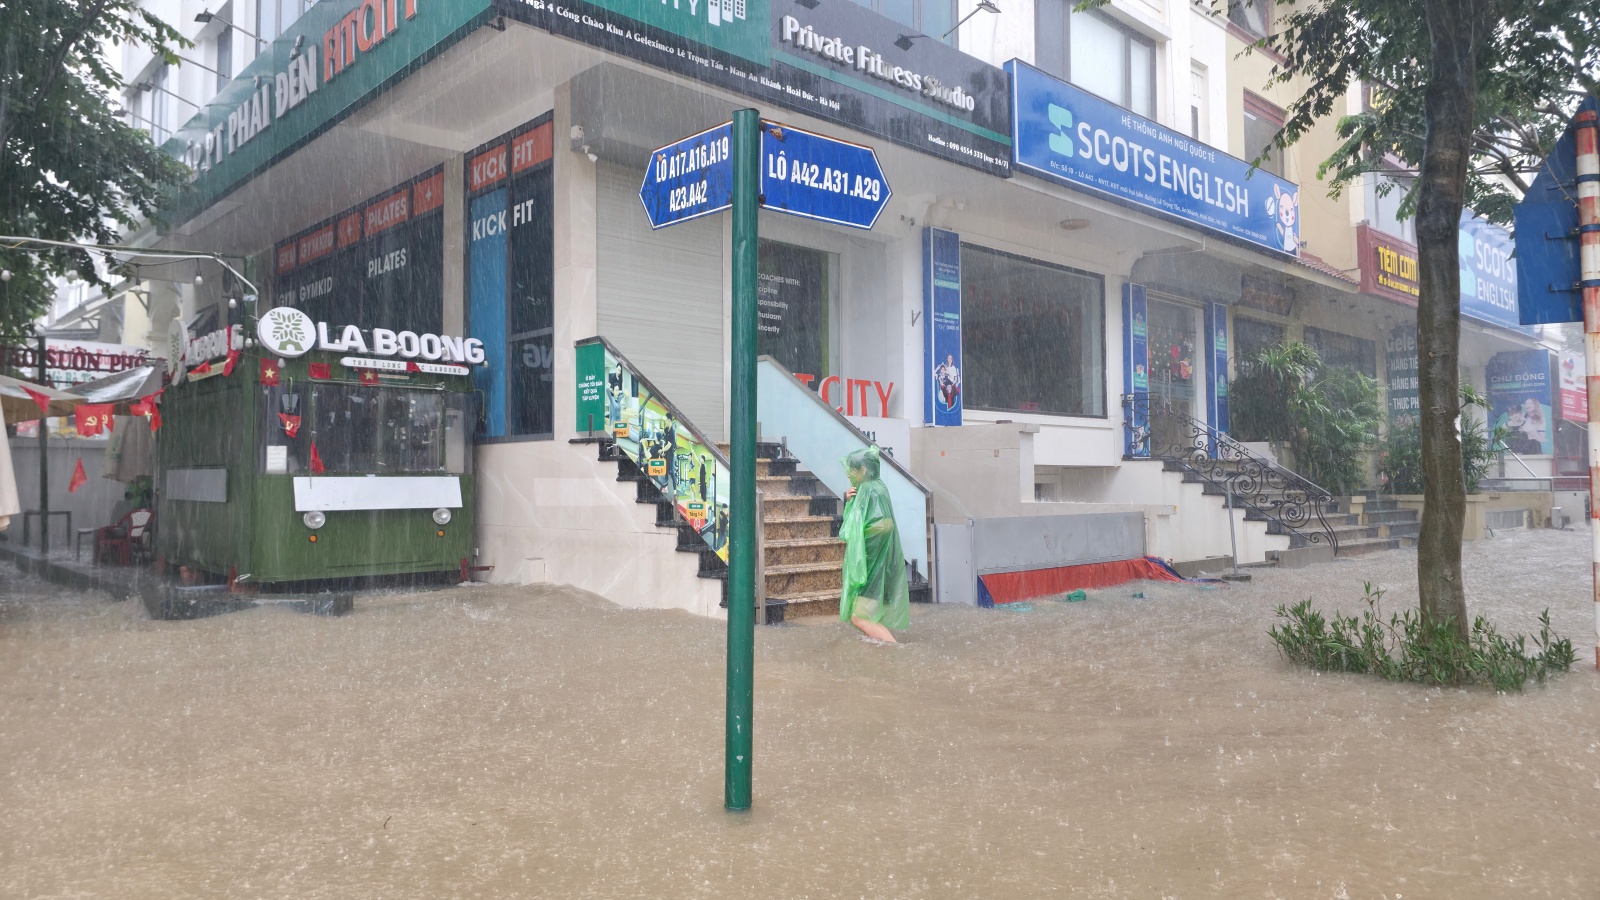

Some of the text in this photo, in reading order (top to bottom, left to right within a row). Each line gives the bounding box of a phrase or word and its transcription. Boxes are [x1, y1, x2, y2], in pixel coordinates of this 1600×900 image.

[547, 4, 554, 12] 4
[606, 22, 623, 36] Khu
[625, 30, 632, 40] A
[634, 33, 674, 54] Geleximco
[677, 48, 685, 57] Lê
[687, 51, 709, 67] Trọng
[711, 59, 723, 71] Tấn
[730, 66, 746, 79] Nam
[748, 73, 758, 82] An
[760, 76, 781, 90] Khánh
[786, 85, 801, 97] Hoài
[802, 90, 814, 101] Đức
[819, 96, 828, 107] Hà
[829, 101, 840, 111] Nội
[780, 15, 975, 111] Private Fitness Studio
[228, 76, 270, 154] PHẢI
[276, 35, 317, 119] ĐẾN
[928, 134, 945, 146] Hotline
[949, 141, 959, 151] 090
[960, 145, 973, 156] 4554
[974, 150, 983, 159] 333
[1121, 115, 1215, 163] HỆ THỐNG ANH NGỮ QUỐC TẾ
[473, 139, 534, 186] KICK FIT
[656, 136, 729, 183] LÔ A17.A16.A19
[768, 150, 880, 202] LÔ A42.A31.A29
[1085, 174, 1094, 182] A42
[669, 180, 708, 212] A23.A42
[302, 230, 334, 260] GYMKID
[368, 197, 407, 230] PILATES
[472, 199, 534, 241] KICK FIT
[300, 276, 333, 301] GYMKID
[368, 248, 407, 278] PILATES
[1475, 238, 1514, 284] SCOTS
[758, 286, 778, 295] cipline
[758, 299, 788, 310] ponsibility
[1477, 277, 1516, 312] ENGLISH
[758, 311, 781, 320] husiasm
[758, 323, 780, 334] incerity
[317, 321, 368, 353] LA
[373, 328, 485, 364] BOONG
[1387, 332, 1418, 352] Gele
[382, 360, 401, 368] LONG
[429, 366, 462, 374] LABOONG
[1391, 354, 1418, 371] HÀNG TIÊ
[820, 376, 894, 418] CITY
[1391, 375, 1419, 390] HÀNG NH
[1393, 396, 1420, 411] THỰC PH
